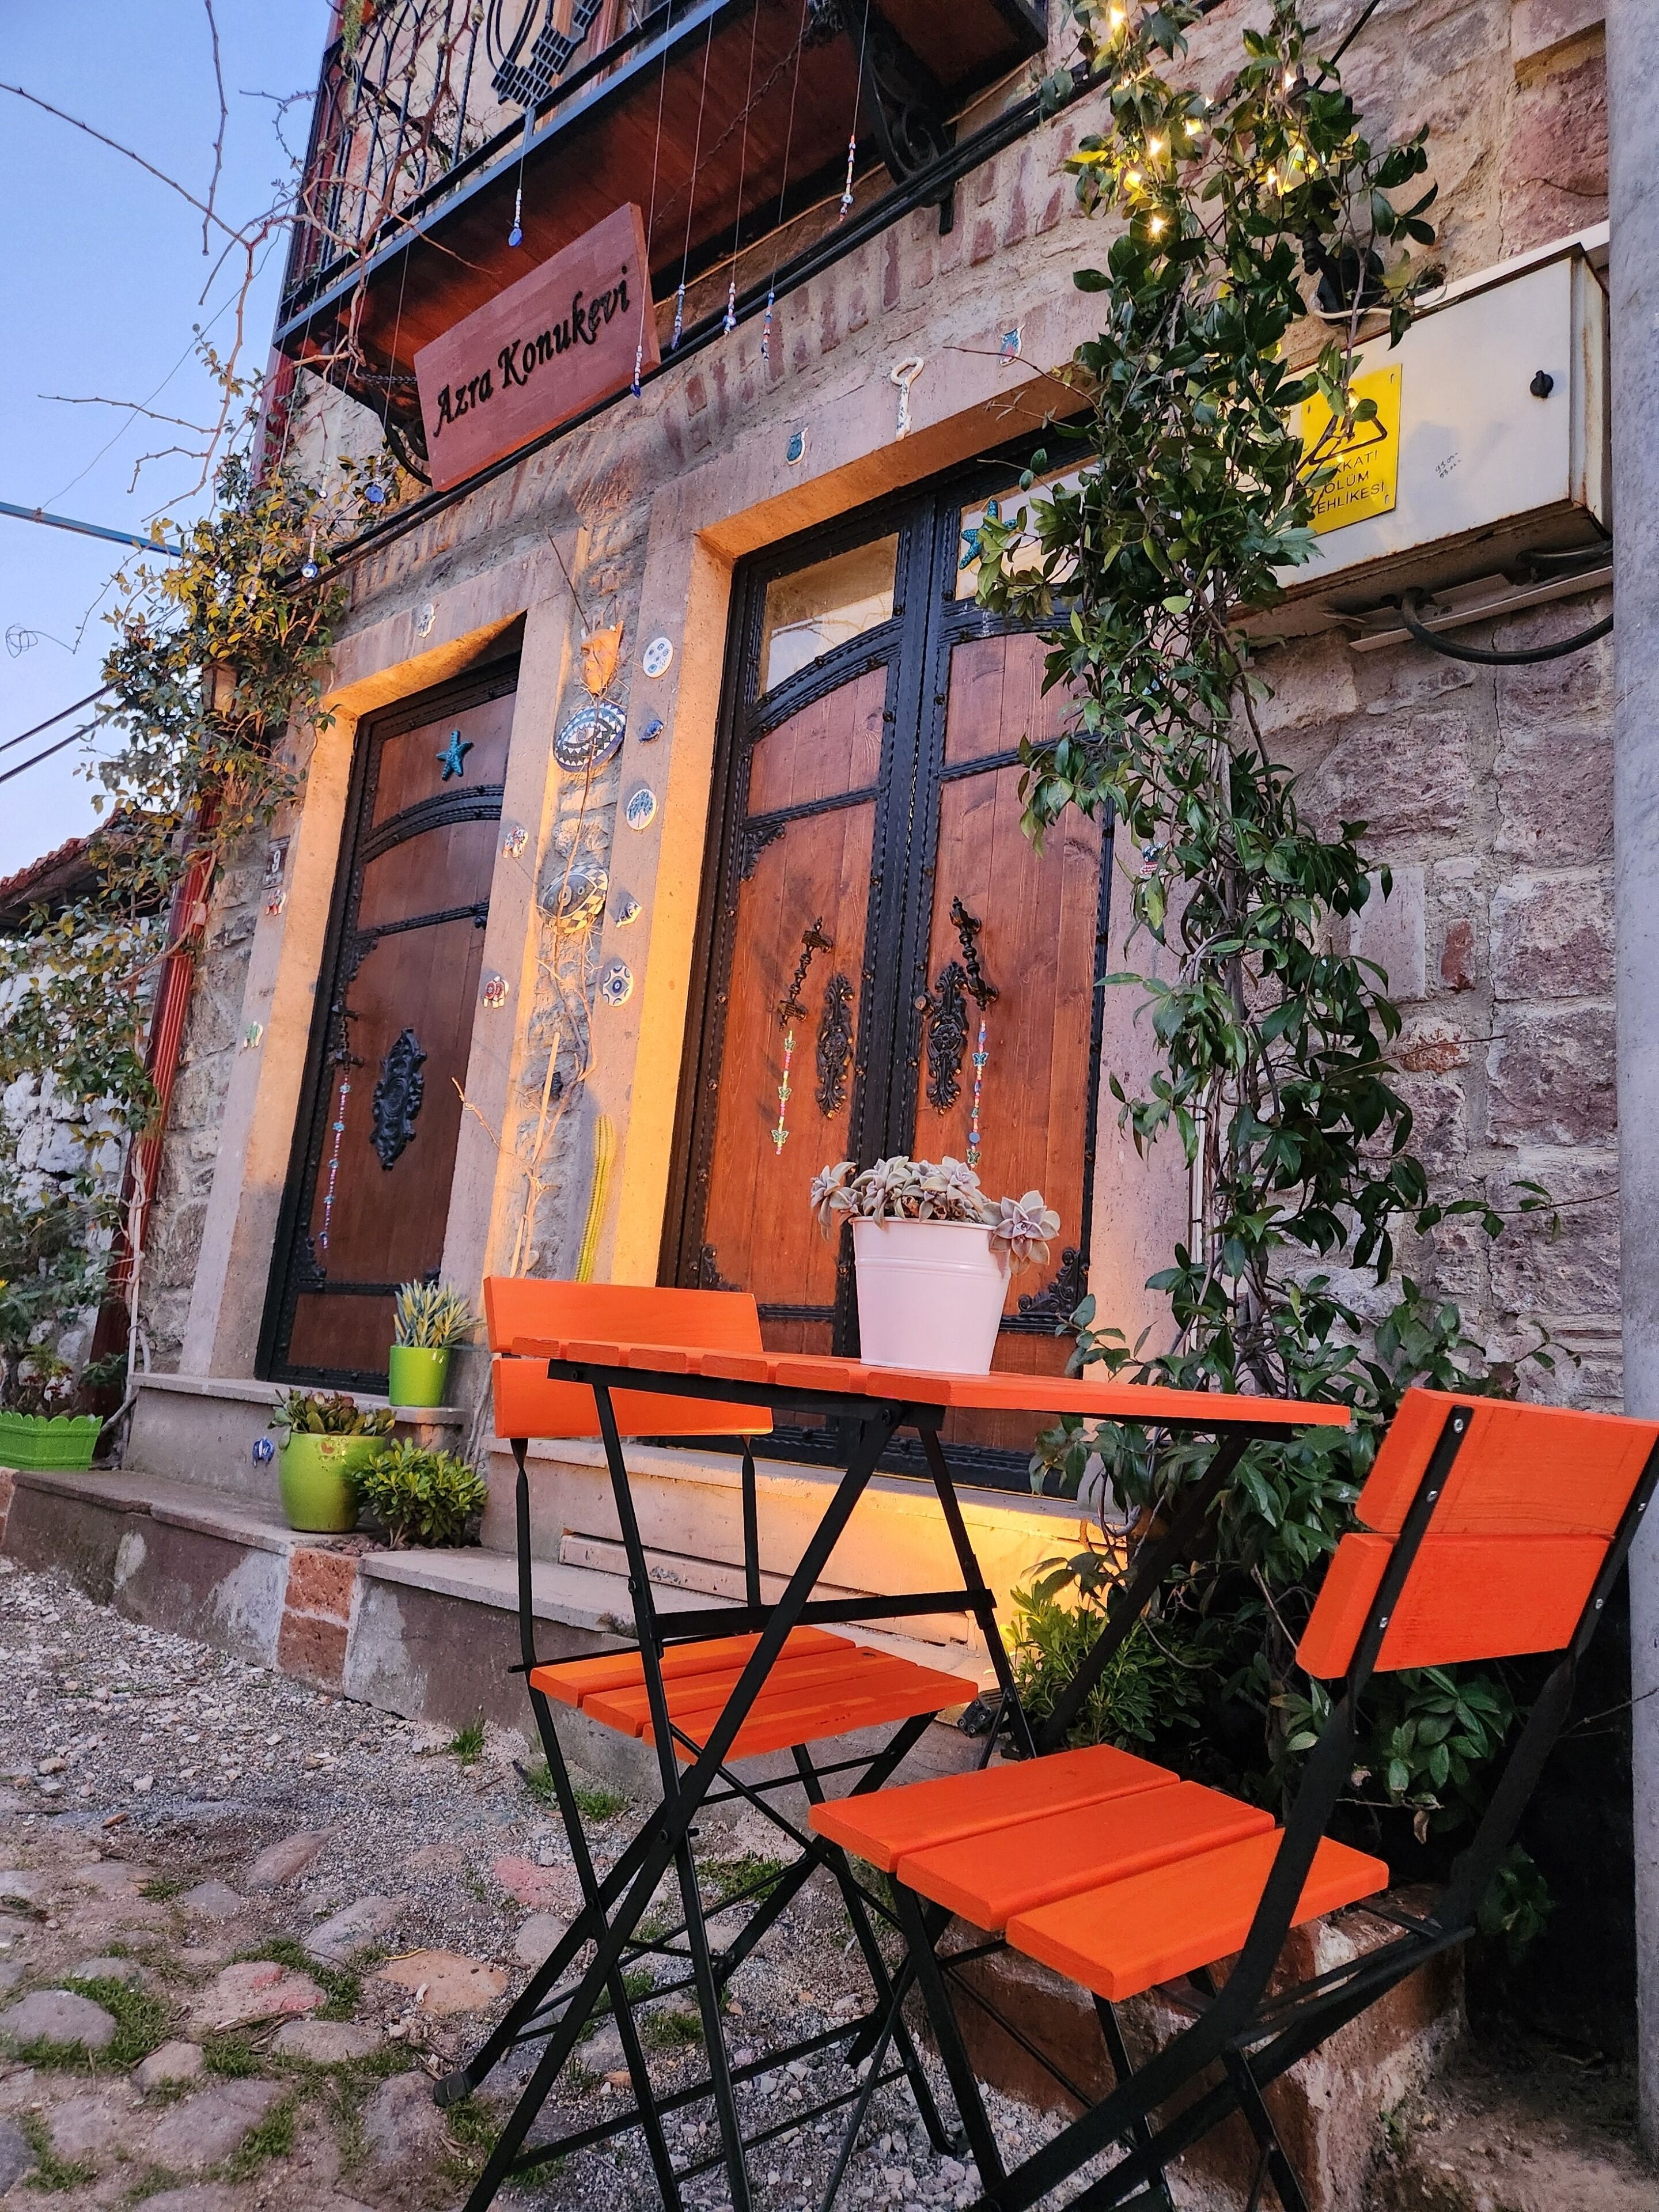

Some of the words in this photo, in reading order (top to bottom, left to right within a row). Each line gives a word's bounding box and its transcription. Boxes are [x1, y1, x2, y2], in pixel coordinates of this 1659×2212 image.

[433, 367, 494, 437] Azra
[498, 265, 631, 389] Konukevi
[271, 849, 281, 873] 9
